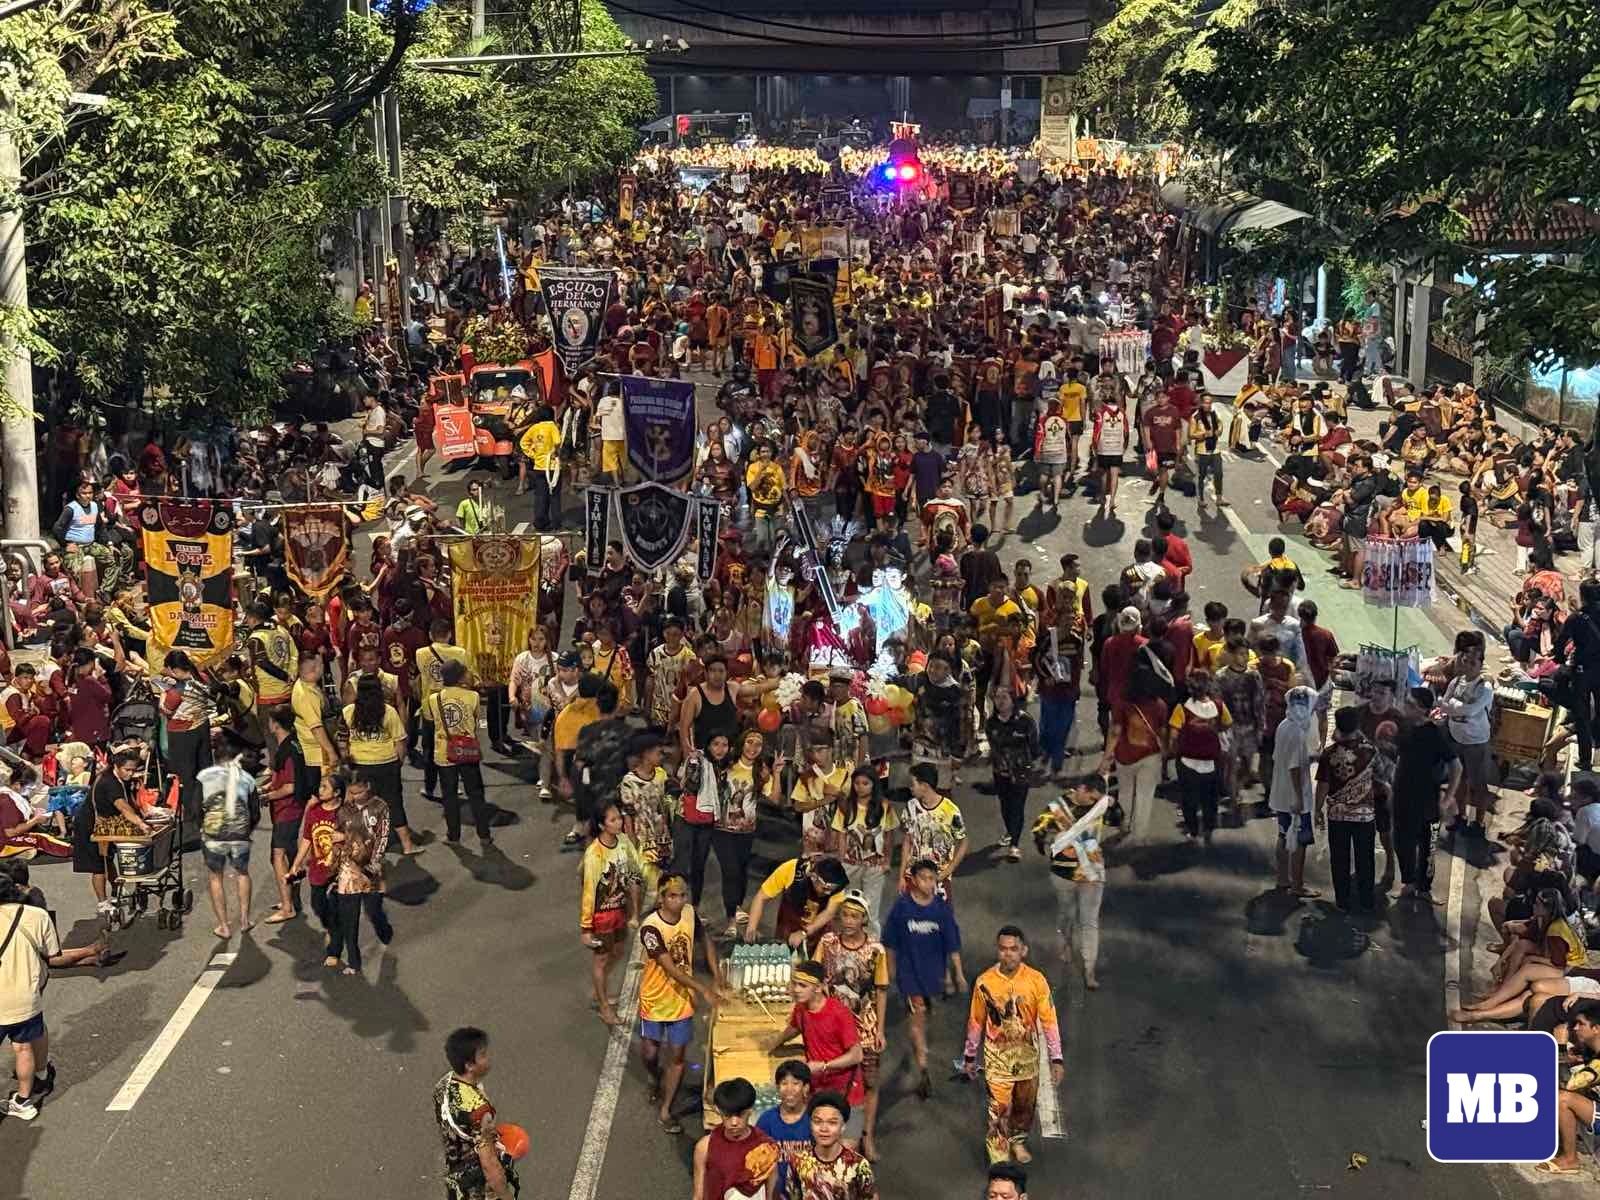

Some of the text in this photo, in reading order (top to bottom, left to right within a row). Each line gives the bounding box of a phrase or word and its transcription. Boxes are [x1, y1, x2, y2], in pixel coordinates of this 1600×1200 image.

[548, 281, 604, 298] ESCUDO
[565, 291, 587, 300] DEL
[550, 300, 602, 309] HERMANOS
[165, 551, 214, 567] LOTE
